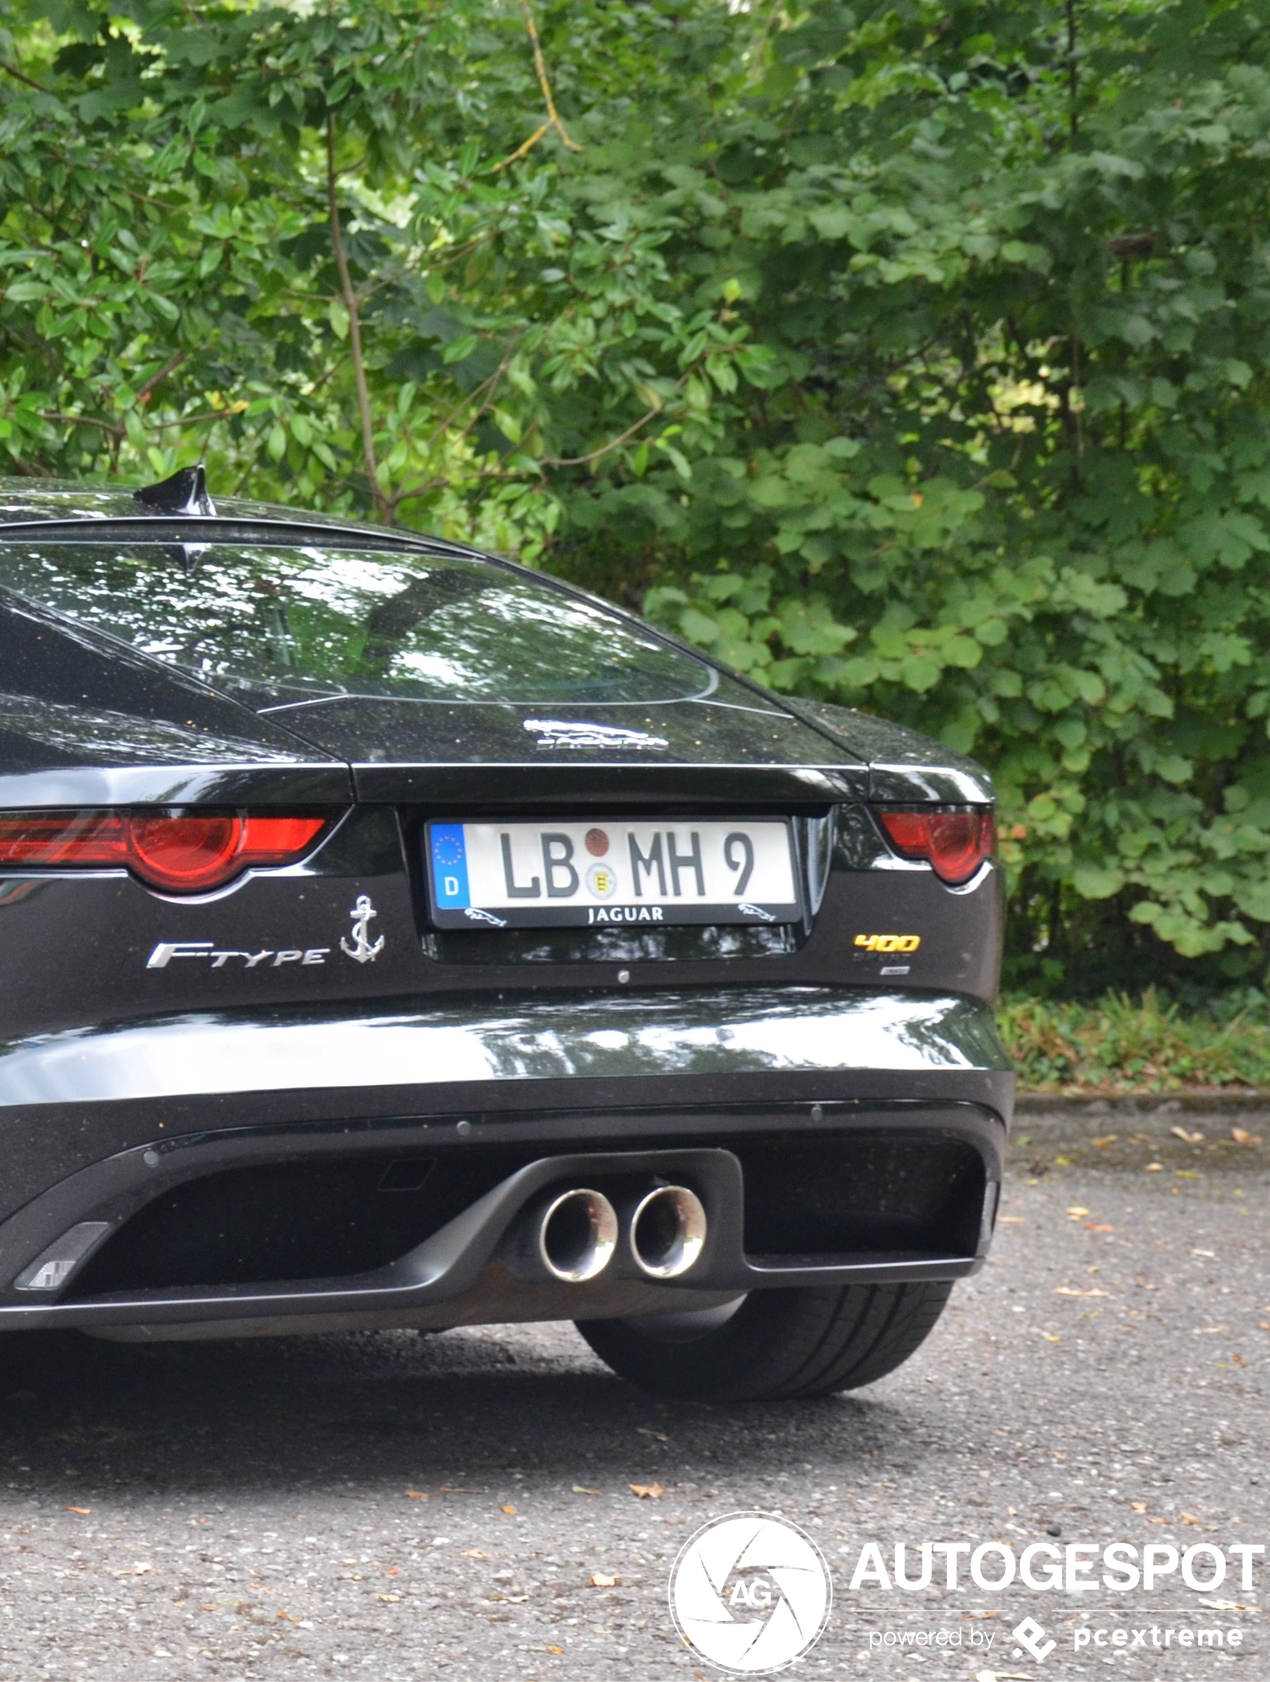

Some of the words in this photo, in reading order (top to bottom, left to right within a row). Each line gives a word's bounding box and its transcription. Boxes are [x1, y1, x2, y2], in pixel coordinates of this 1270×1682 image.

[500, 832, 580, 899] LB
[627, 831, 706, 897] MH
[723, 832, 755, 896] 9
[444, 876, 459, 896] D
[588, 906, 664, 924] JAGUAR
[853, 934, 921, 953] 400
